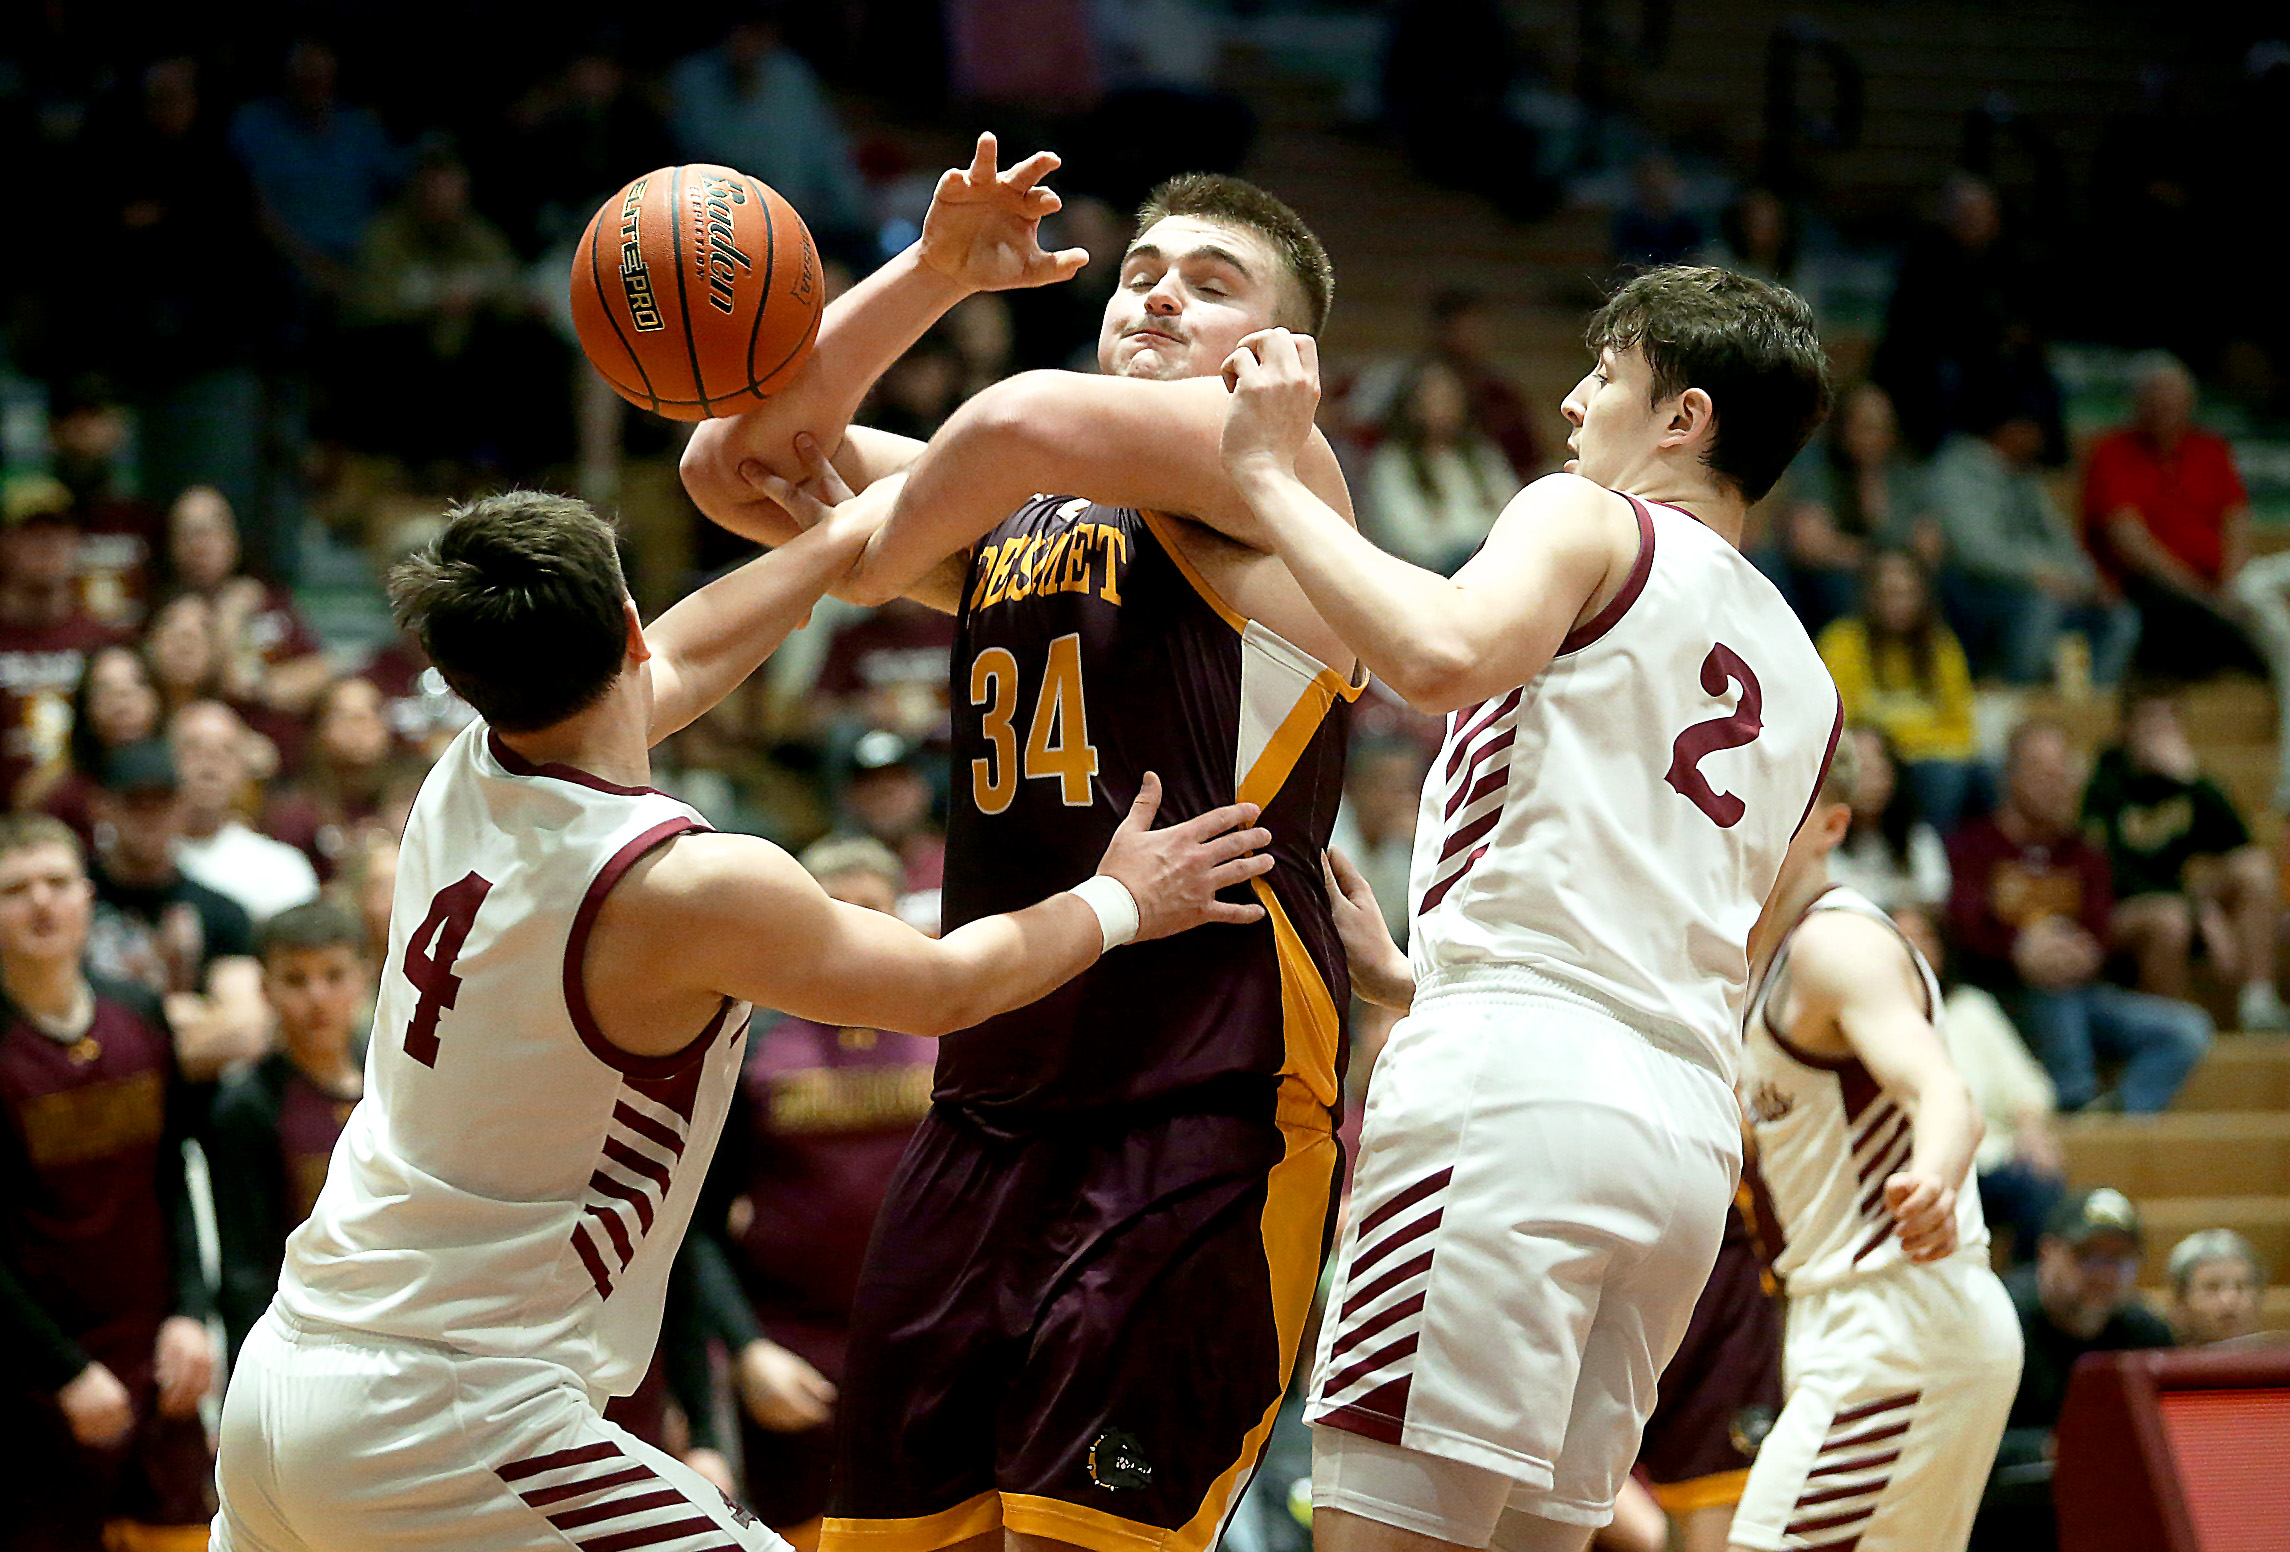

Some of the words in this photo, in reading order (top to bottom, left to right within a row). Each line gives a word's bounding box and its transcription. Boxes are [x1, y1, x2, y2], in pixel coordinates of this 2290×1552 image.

[699, 172, 752, 316] Baden
[970, 632, 1099, 815] 34
[1665, 643, 1764, 828] 2
[402, 870, 493, 1069] 4
